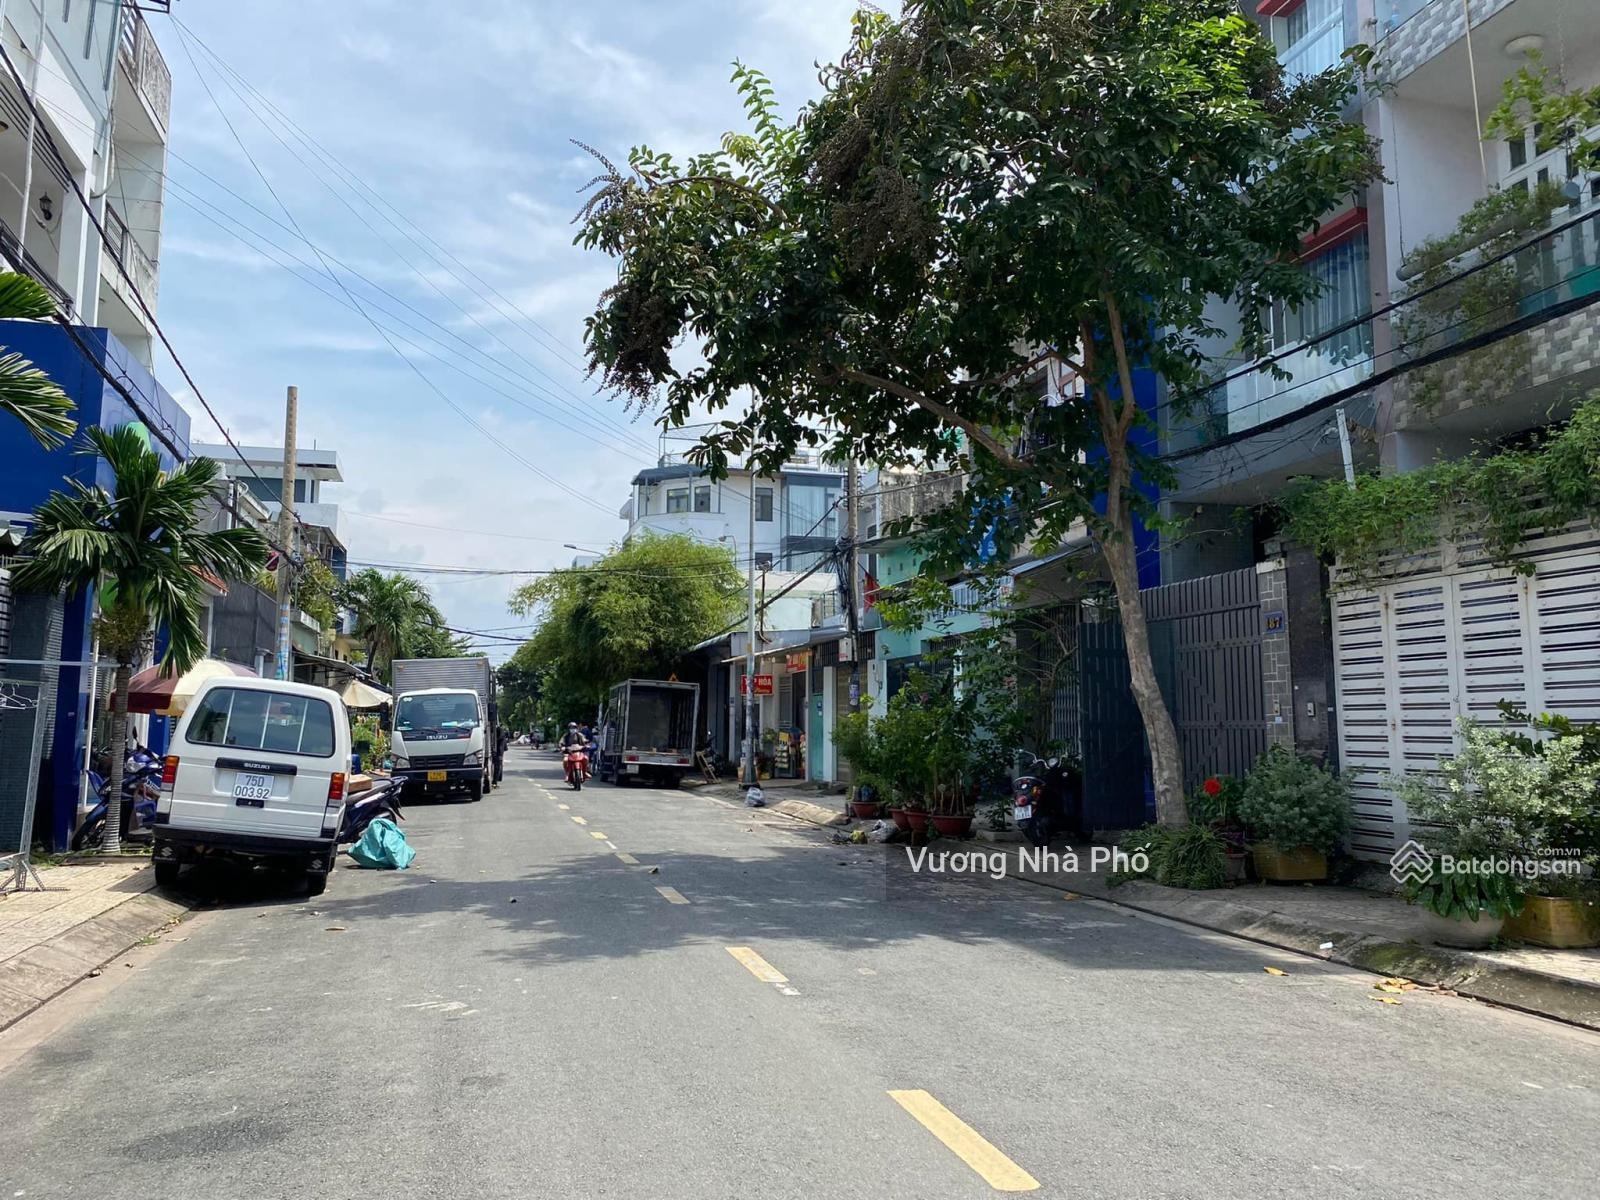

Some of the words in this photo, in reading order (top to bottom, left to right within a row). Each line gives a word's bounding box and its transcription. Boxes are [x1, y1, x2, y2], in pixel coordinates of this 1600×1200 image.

[243, 762, 271, 770] SUZUKI
[245, 774, 265, 787] 75D
[234, 785, 270, 799] 003.92
